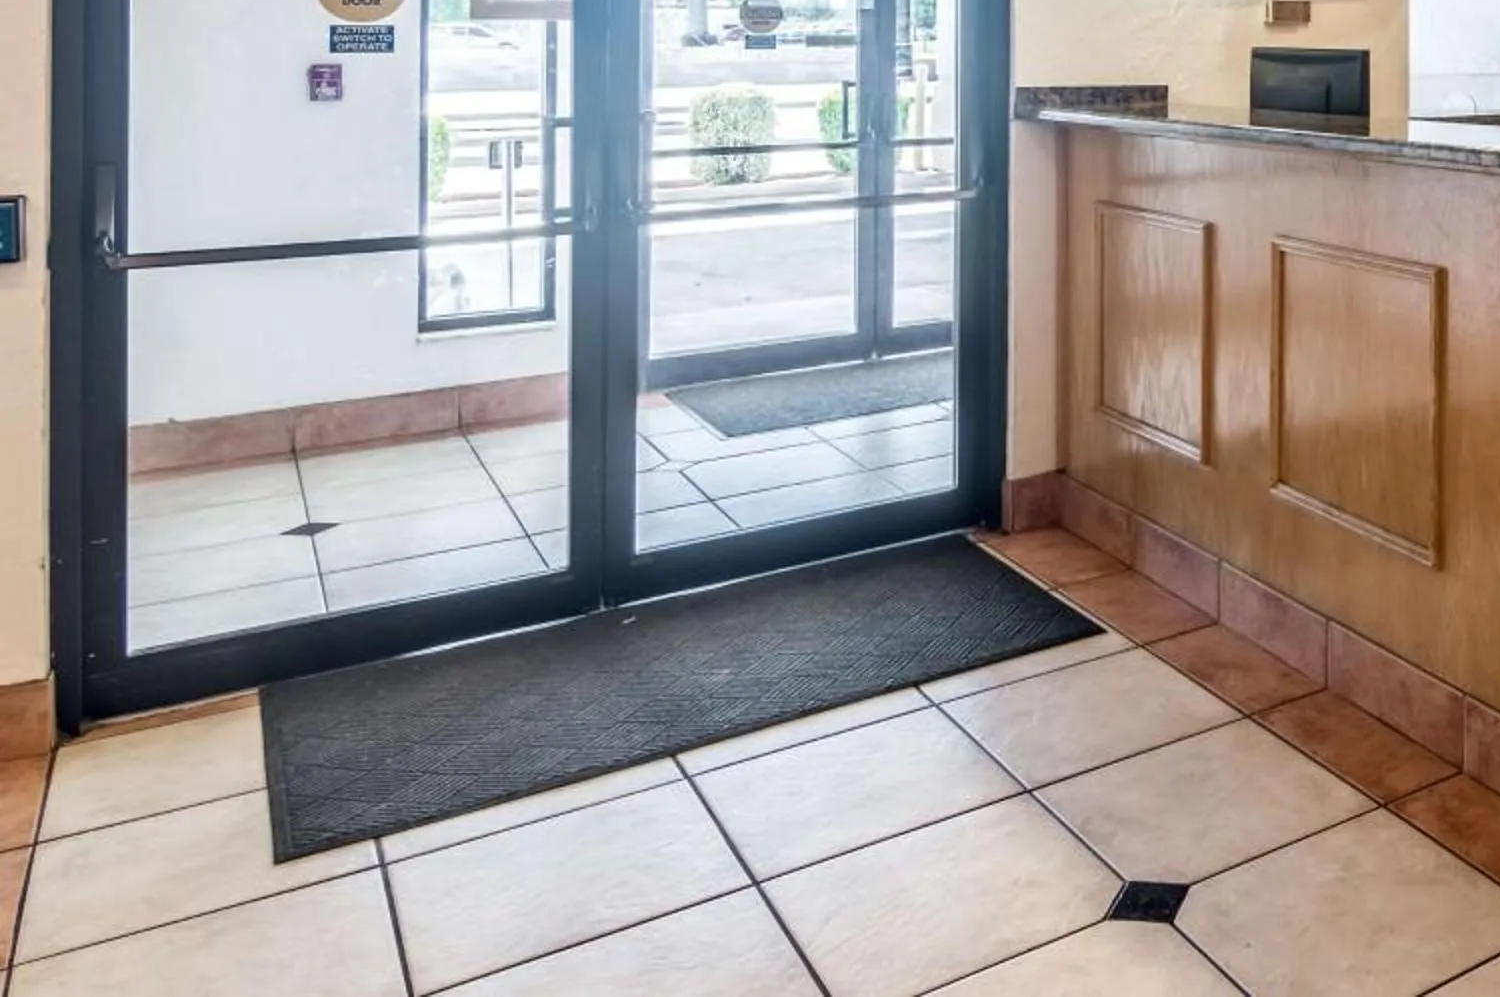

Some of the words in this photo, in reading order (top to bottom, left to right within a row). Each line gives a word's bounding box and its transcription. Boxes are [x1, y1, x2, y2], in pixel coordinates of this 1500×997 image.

[336, 26, 388, 35] ACTIVATE
[333, 34, 375, 43] SWITCH
[378, 35, 393, 43] TO
[336, 43, 388, 52] OPERATE
